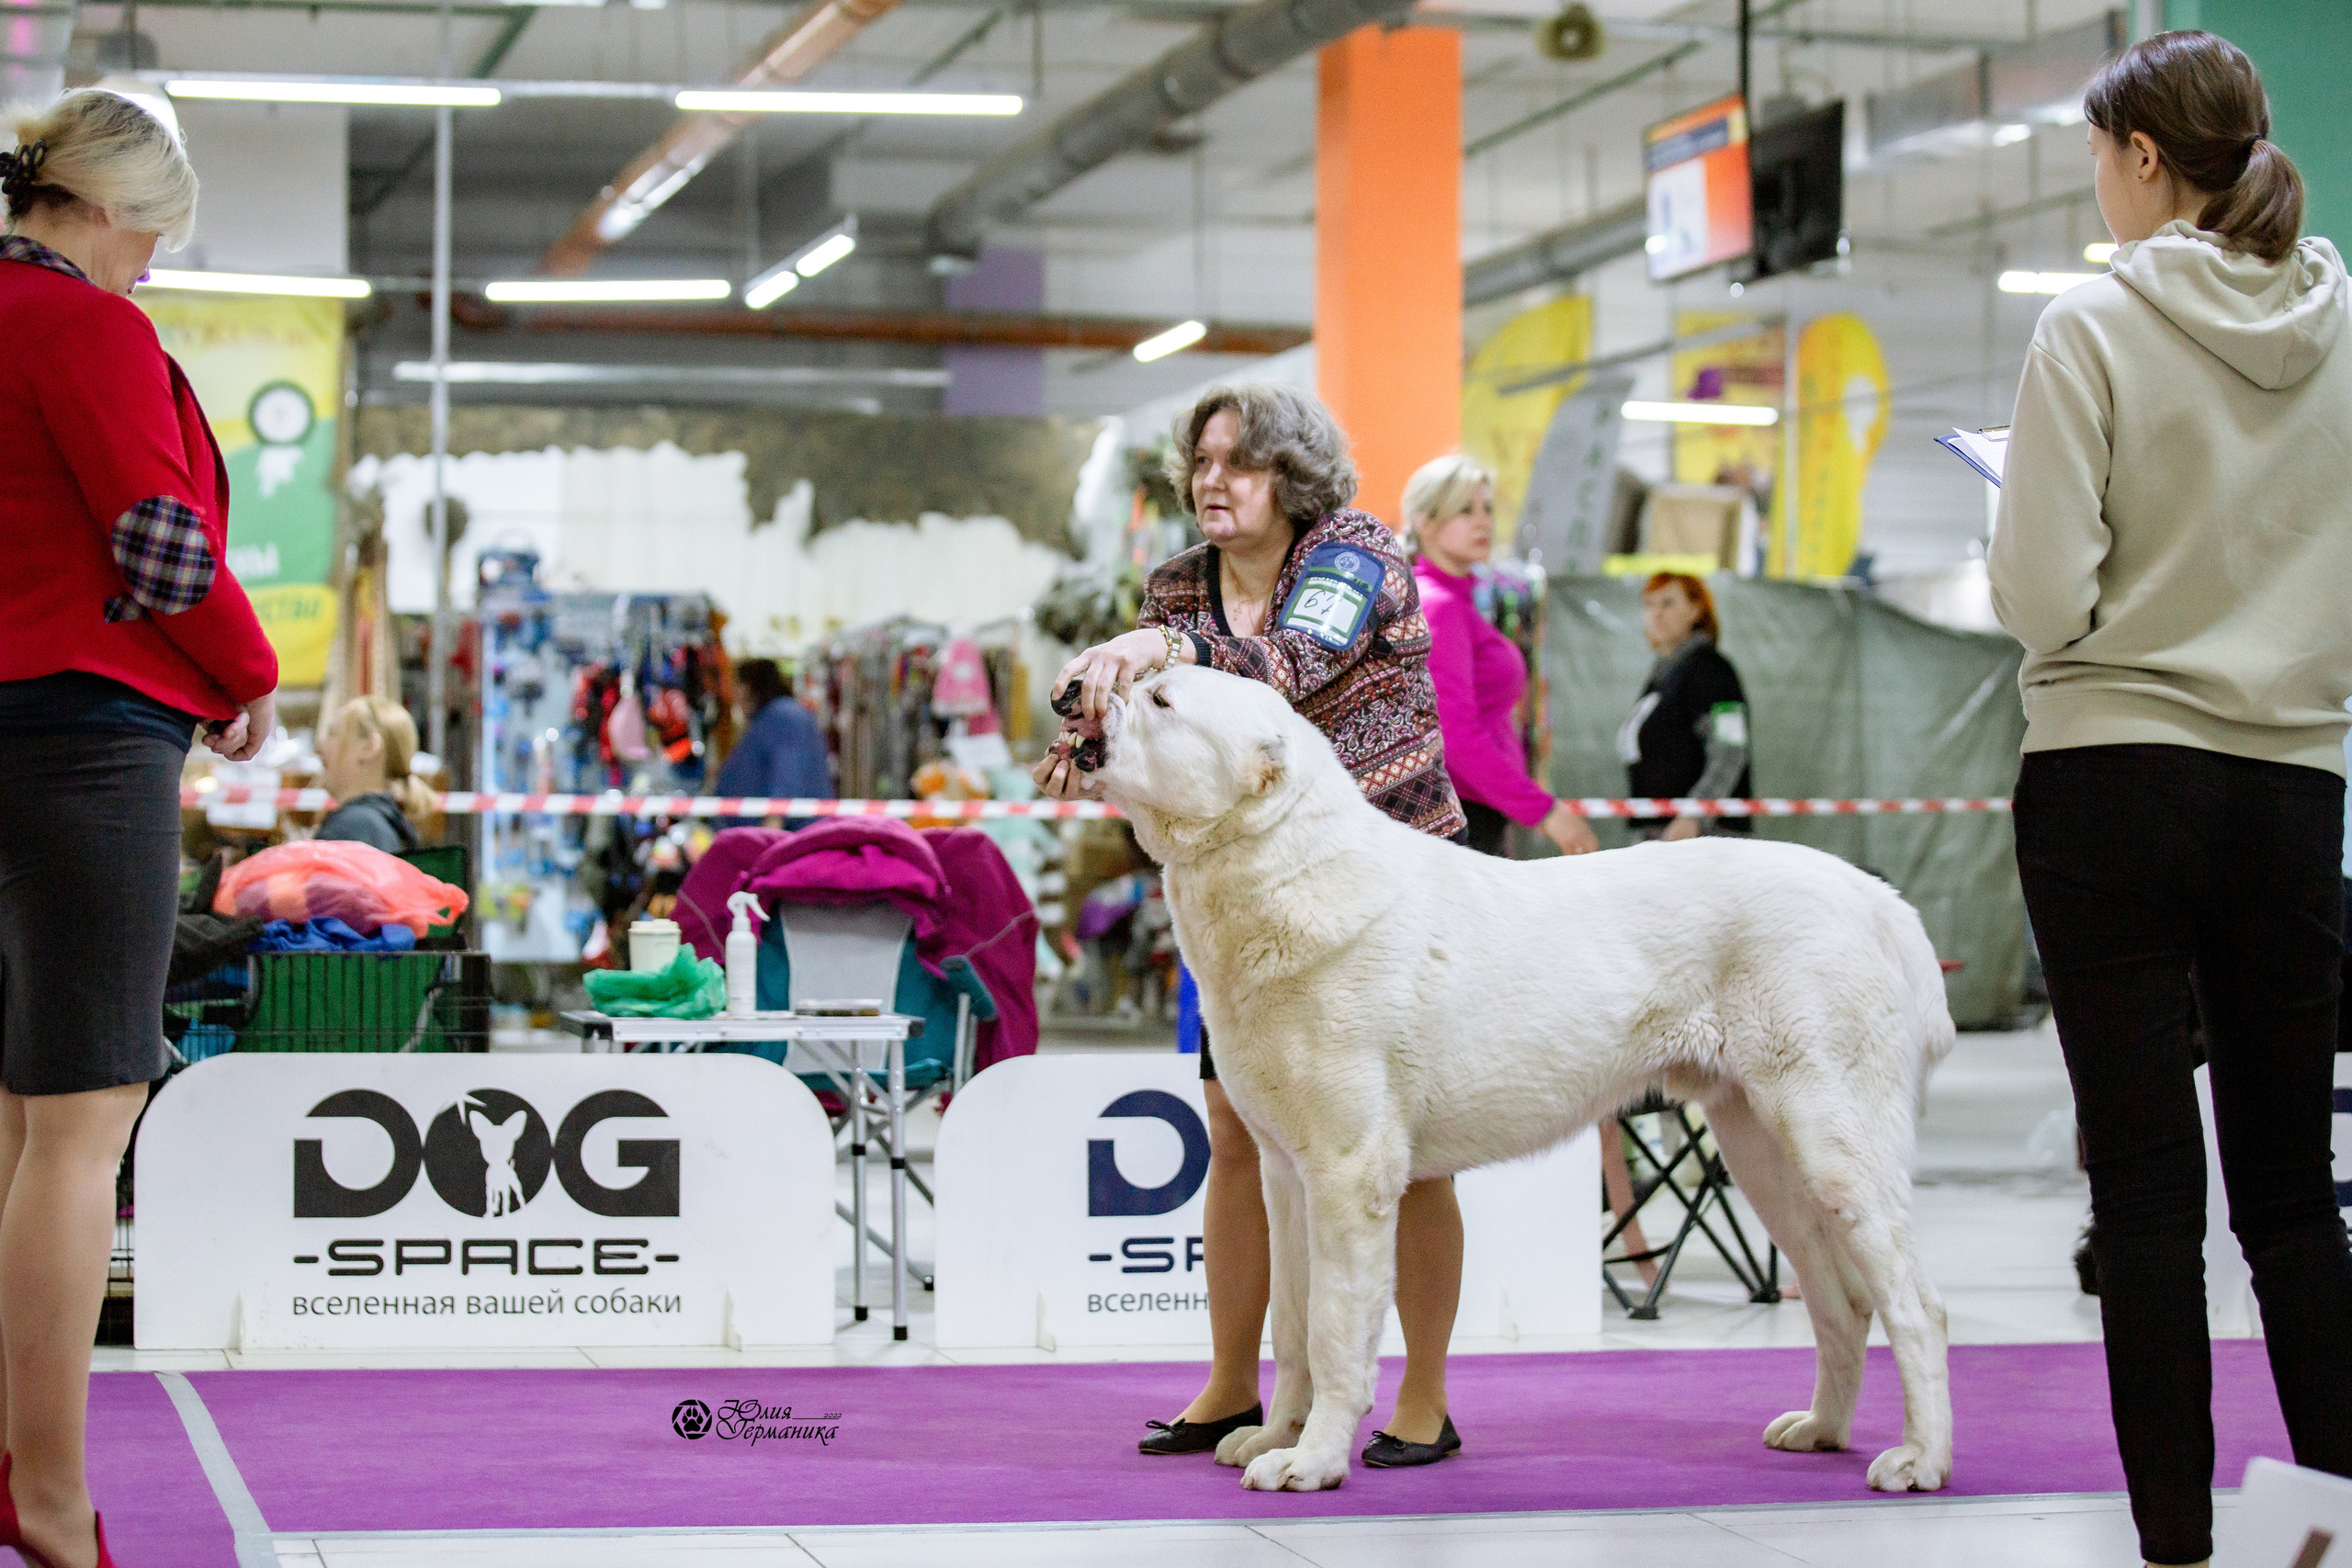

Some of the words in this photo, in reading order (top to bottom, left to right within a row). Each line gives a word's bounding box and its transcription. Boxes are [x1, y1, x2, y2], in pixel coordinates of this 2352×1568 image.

[293, 1088, 681, 1219] DOG
[293, 1294, 455, 1316] вселенная
[467, 1289, 563, 1315] вашей
[575, 1287, 681, 1314] собаки
[1088, 1292, 1208, 1314] вселенн
